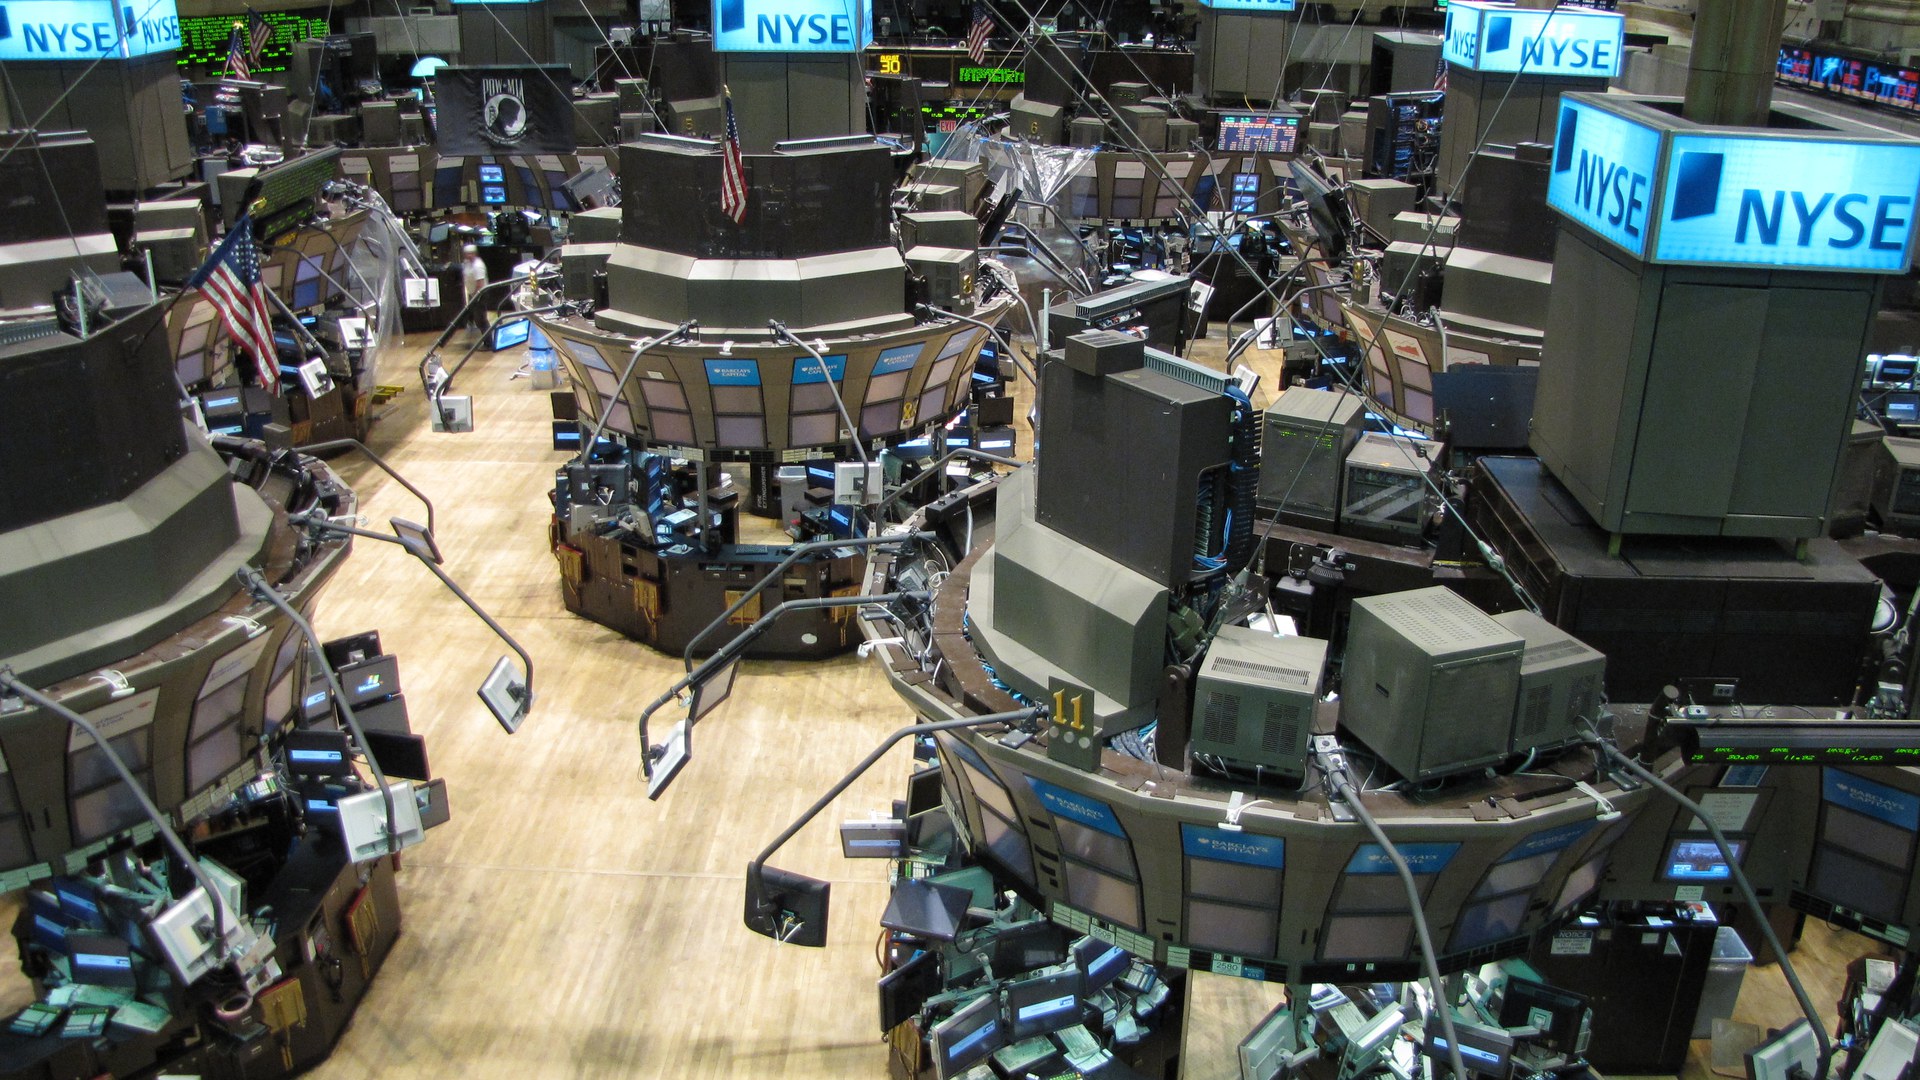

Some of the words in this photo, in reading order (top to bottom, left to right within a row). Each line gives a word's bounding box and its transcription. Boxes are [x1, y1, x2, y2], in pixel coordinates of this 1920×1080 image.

[22, 22, 116, 53] NYSE
[142, 15, 181, 46] NYSE
[757, 14, 849, 44] NYSE
[1452, 29, 1476, 60] NYSE
[1520, 36, 1612, 70] NYSE
[880, 60, 900, 73] 30
[482, 79, 503, 104] POW
[507, 79, 525, 105] MIA
[940, 121, 956, 132] EXIT
[1031, 121, 1038, 134] 6
[1574, 148, 1647, 238] NYSE
[1734, 188, 1911, 251] NYSE
[1053, 688, 1085, 731] 11
[1055, 796, 1104, 818] BARCLAYS
[1849, 791, 1896, 812] CAPITAL
[1850, 787, 1904, 810] BARCLAYS
[1058, 801, 1101, 820] CAPITAL
[1211, 845, 1259, 855] CAPITAL
[1212, 839, 1268, 853] BARCLAYS
[1216, 961, 1238, 971] 2580
